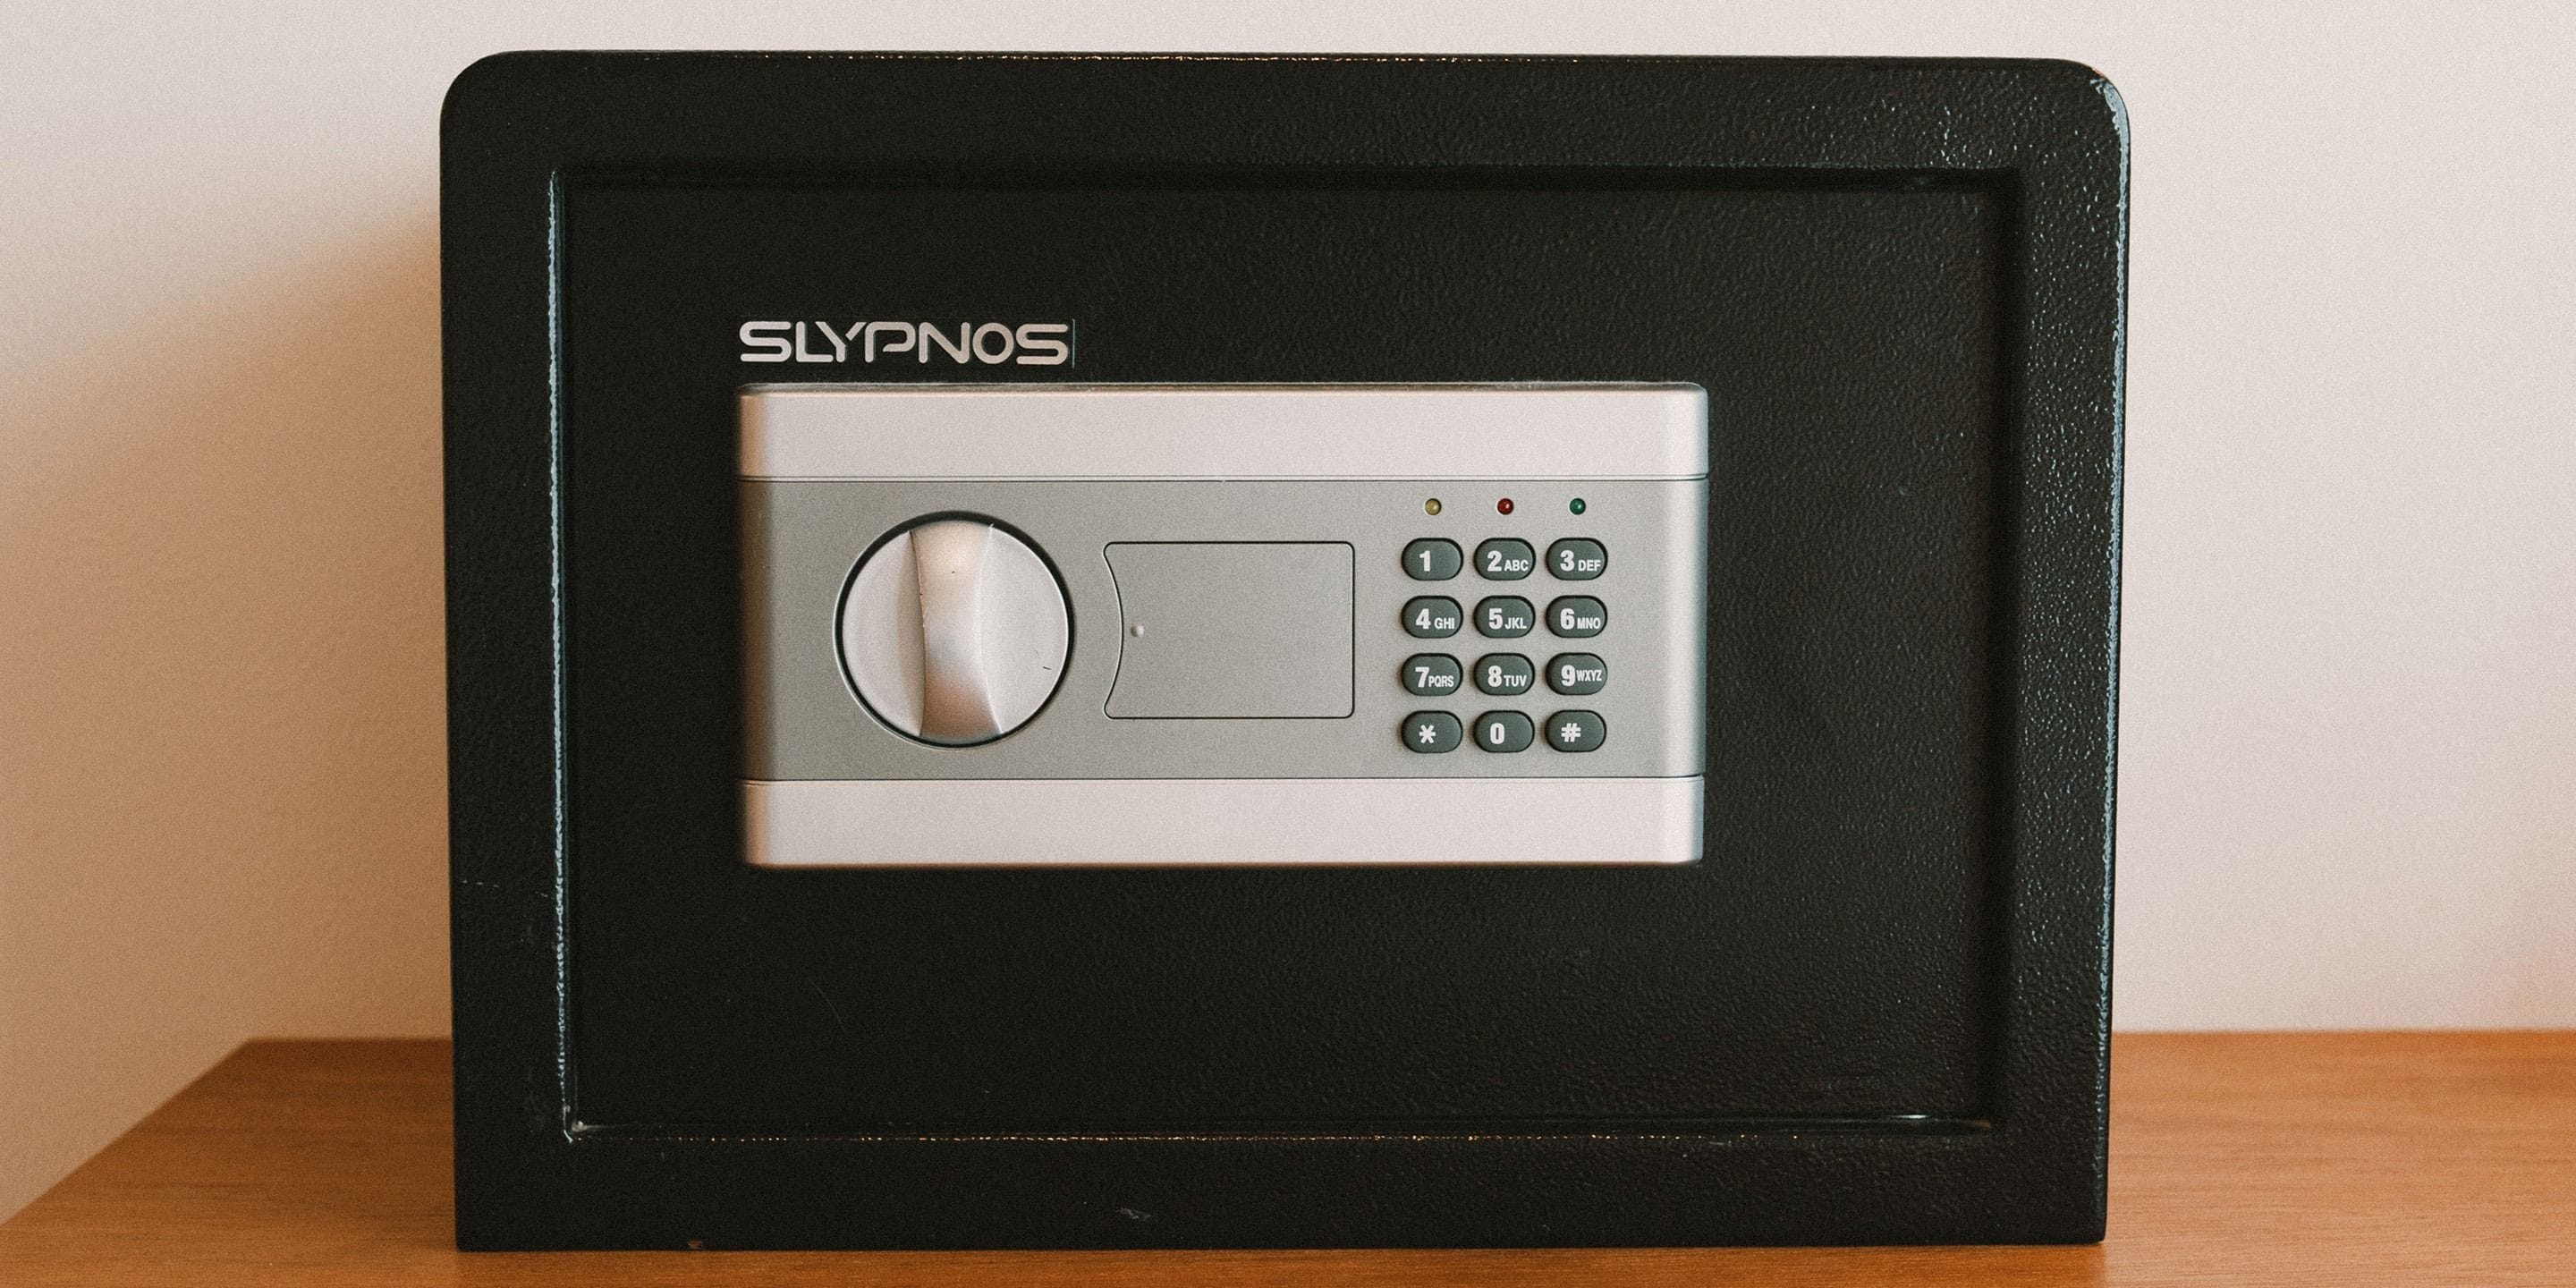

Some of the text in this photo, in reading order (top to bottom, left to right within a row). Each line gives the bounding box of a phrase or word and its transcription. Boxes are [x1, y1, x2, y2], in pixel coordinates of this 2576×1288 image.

[739, 320, 1069, 365] SLYPNOS
[1419, 550, 1431, 572] 1
[1487, 550, 1529, 572] 2 ABC
[1560, 550, 1601, 572] 3 DEF
[1415, 608, 1455, 630] 4 GHI
[1488, 608, 1527, 630] 5 JKL
[1560, 608, 1601, 630] 6 MNO
[1415, 666, 1454, 688] 7 PQRS
[1487, 665, 1527, 687] 8 TUV
[1561, 665, 1602, 687] 9 WXYZ
[1489, 723, 1505, 745] 0
